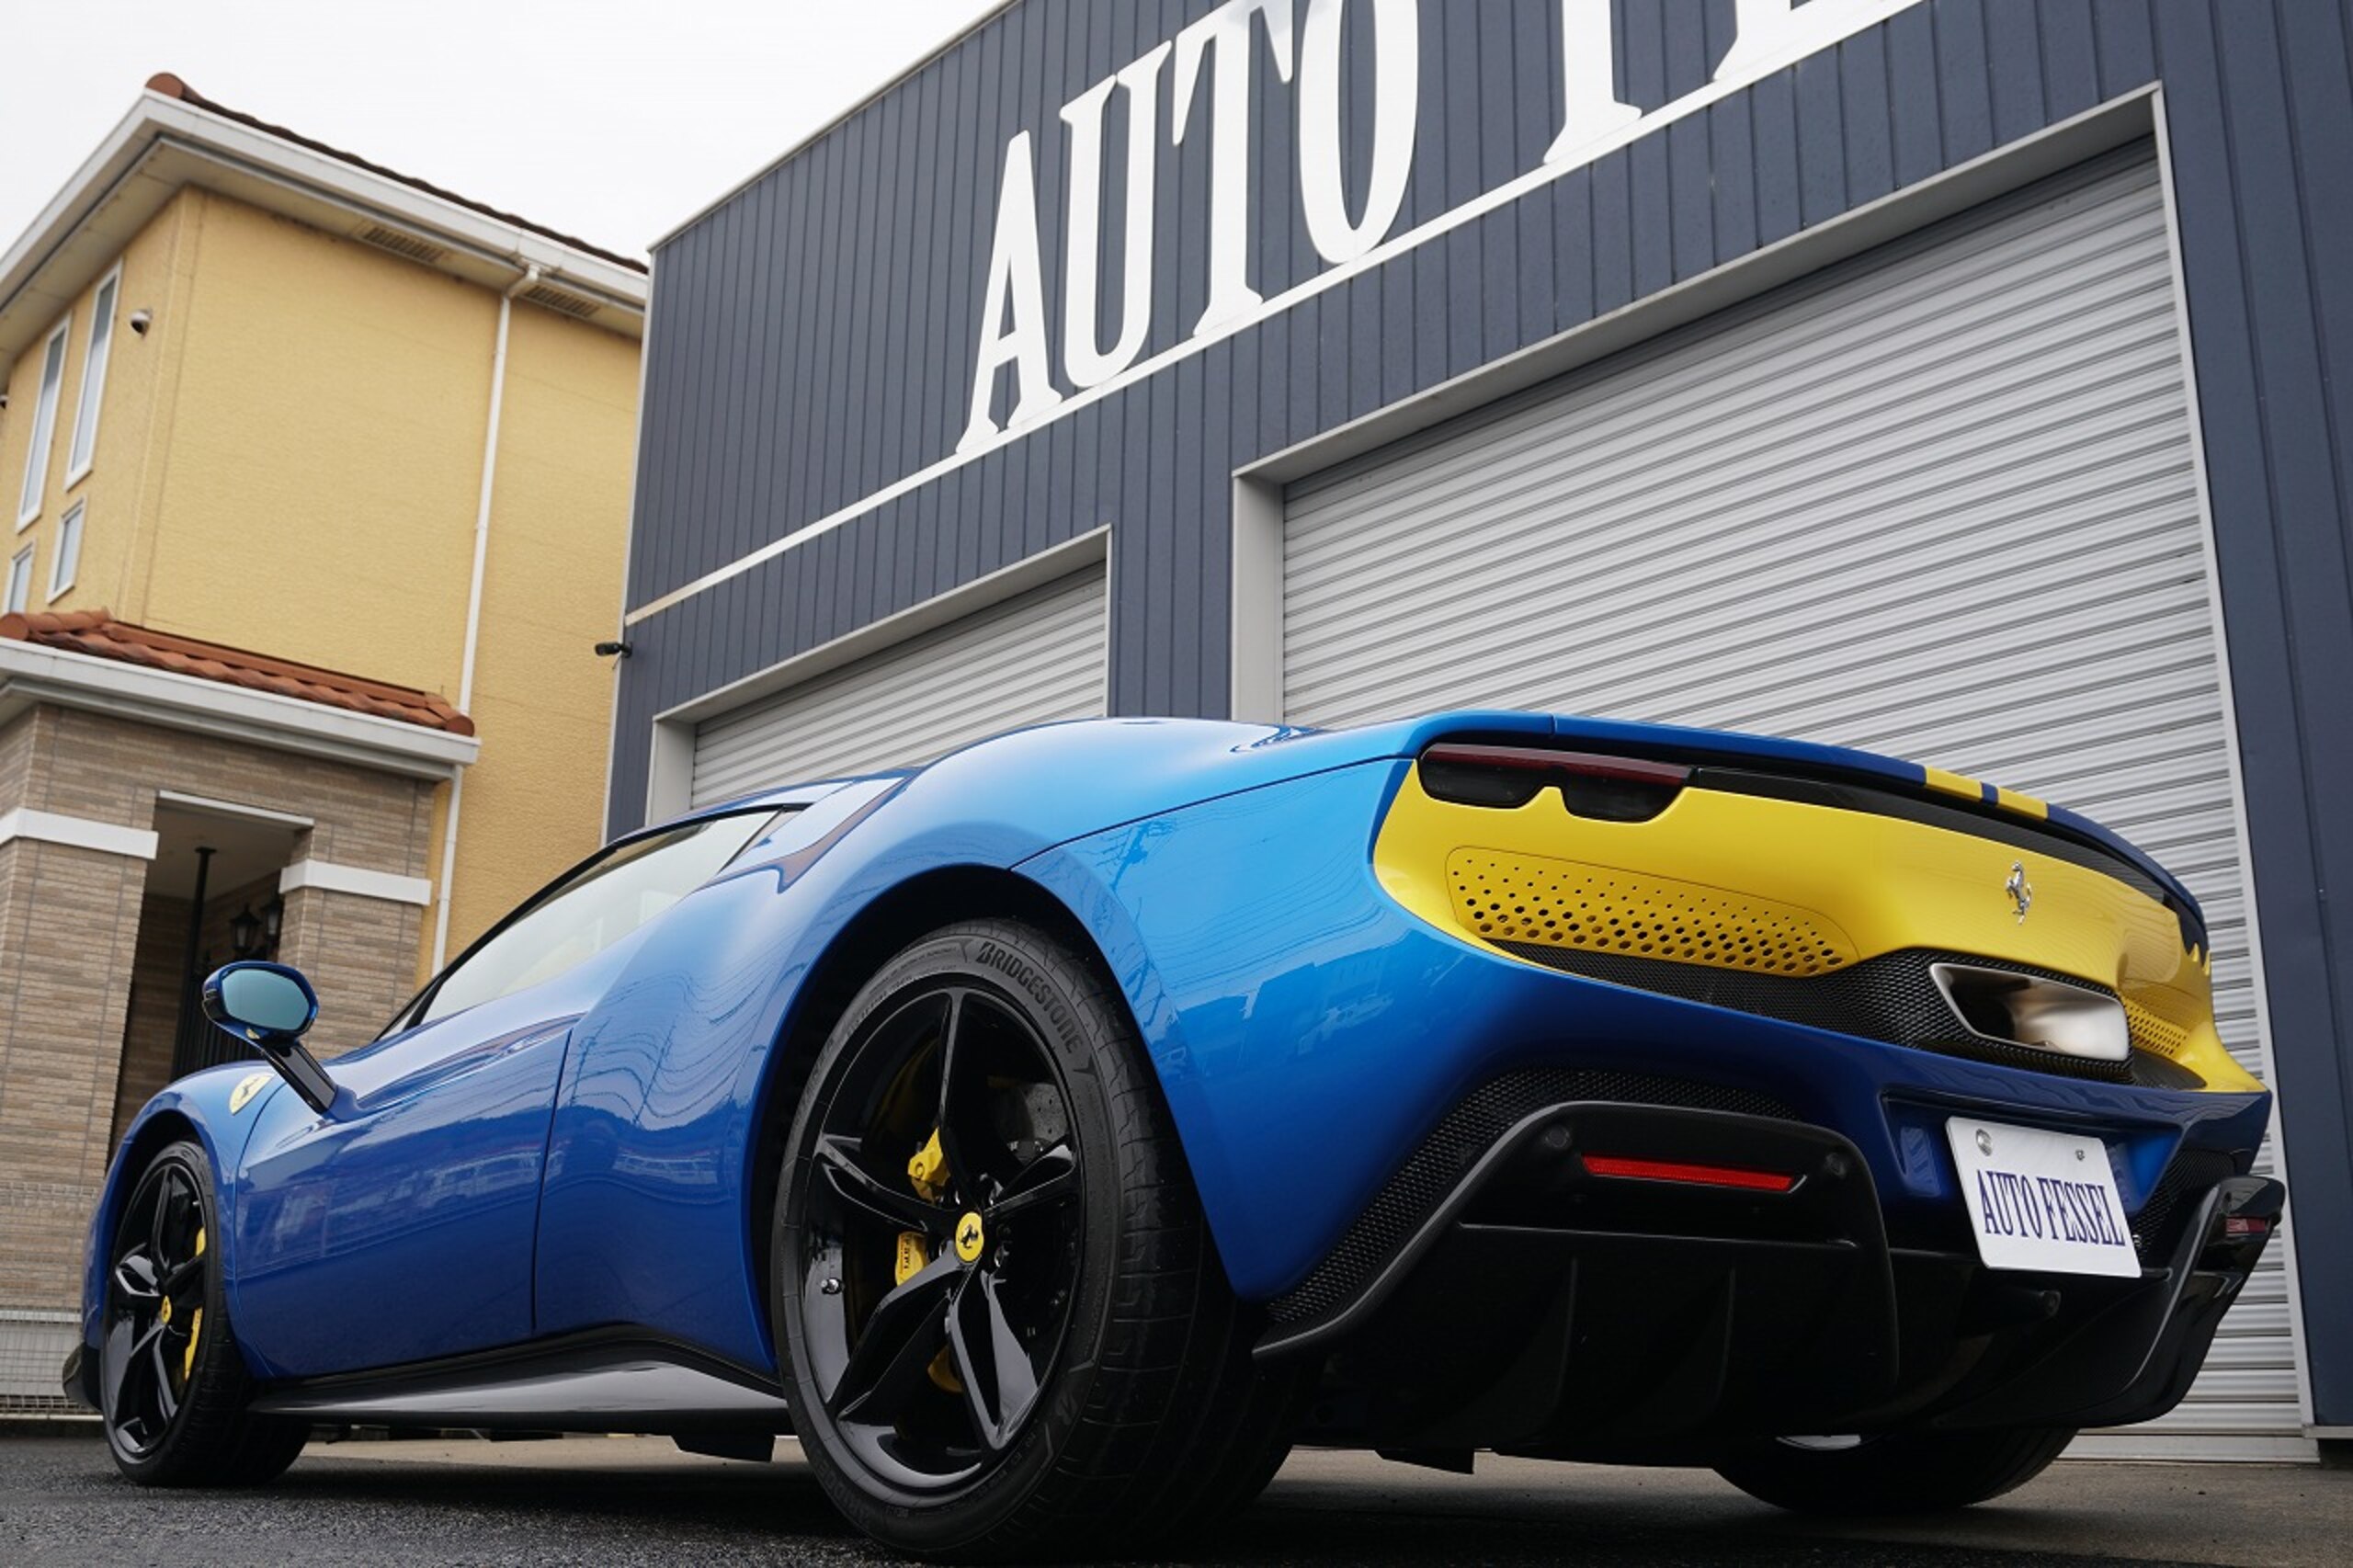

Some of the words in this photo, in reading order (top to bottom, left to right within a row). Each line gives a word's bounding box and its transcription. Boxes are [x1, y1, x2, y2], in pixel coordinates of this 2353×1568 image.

[956, 0, 1418, 454] AUTO
[975, 940, 1084, 1054] BRIDGESTONE
[1976, 1168, 2043, 1240] AUTO
[2036, 1176, 2126, 1247] FESSEL
